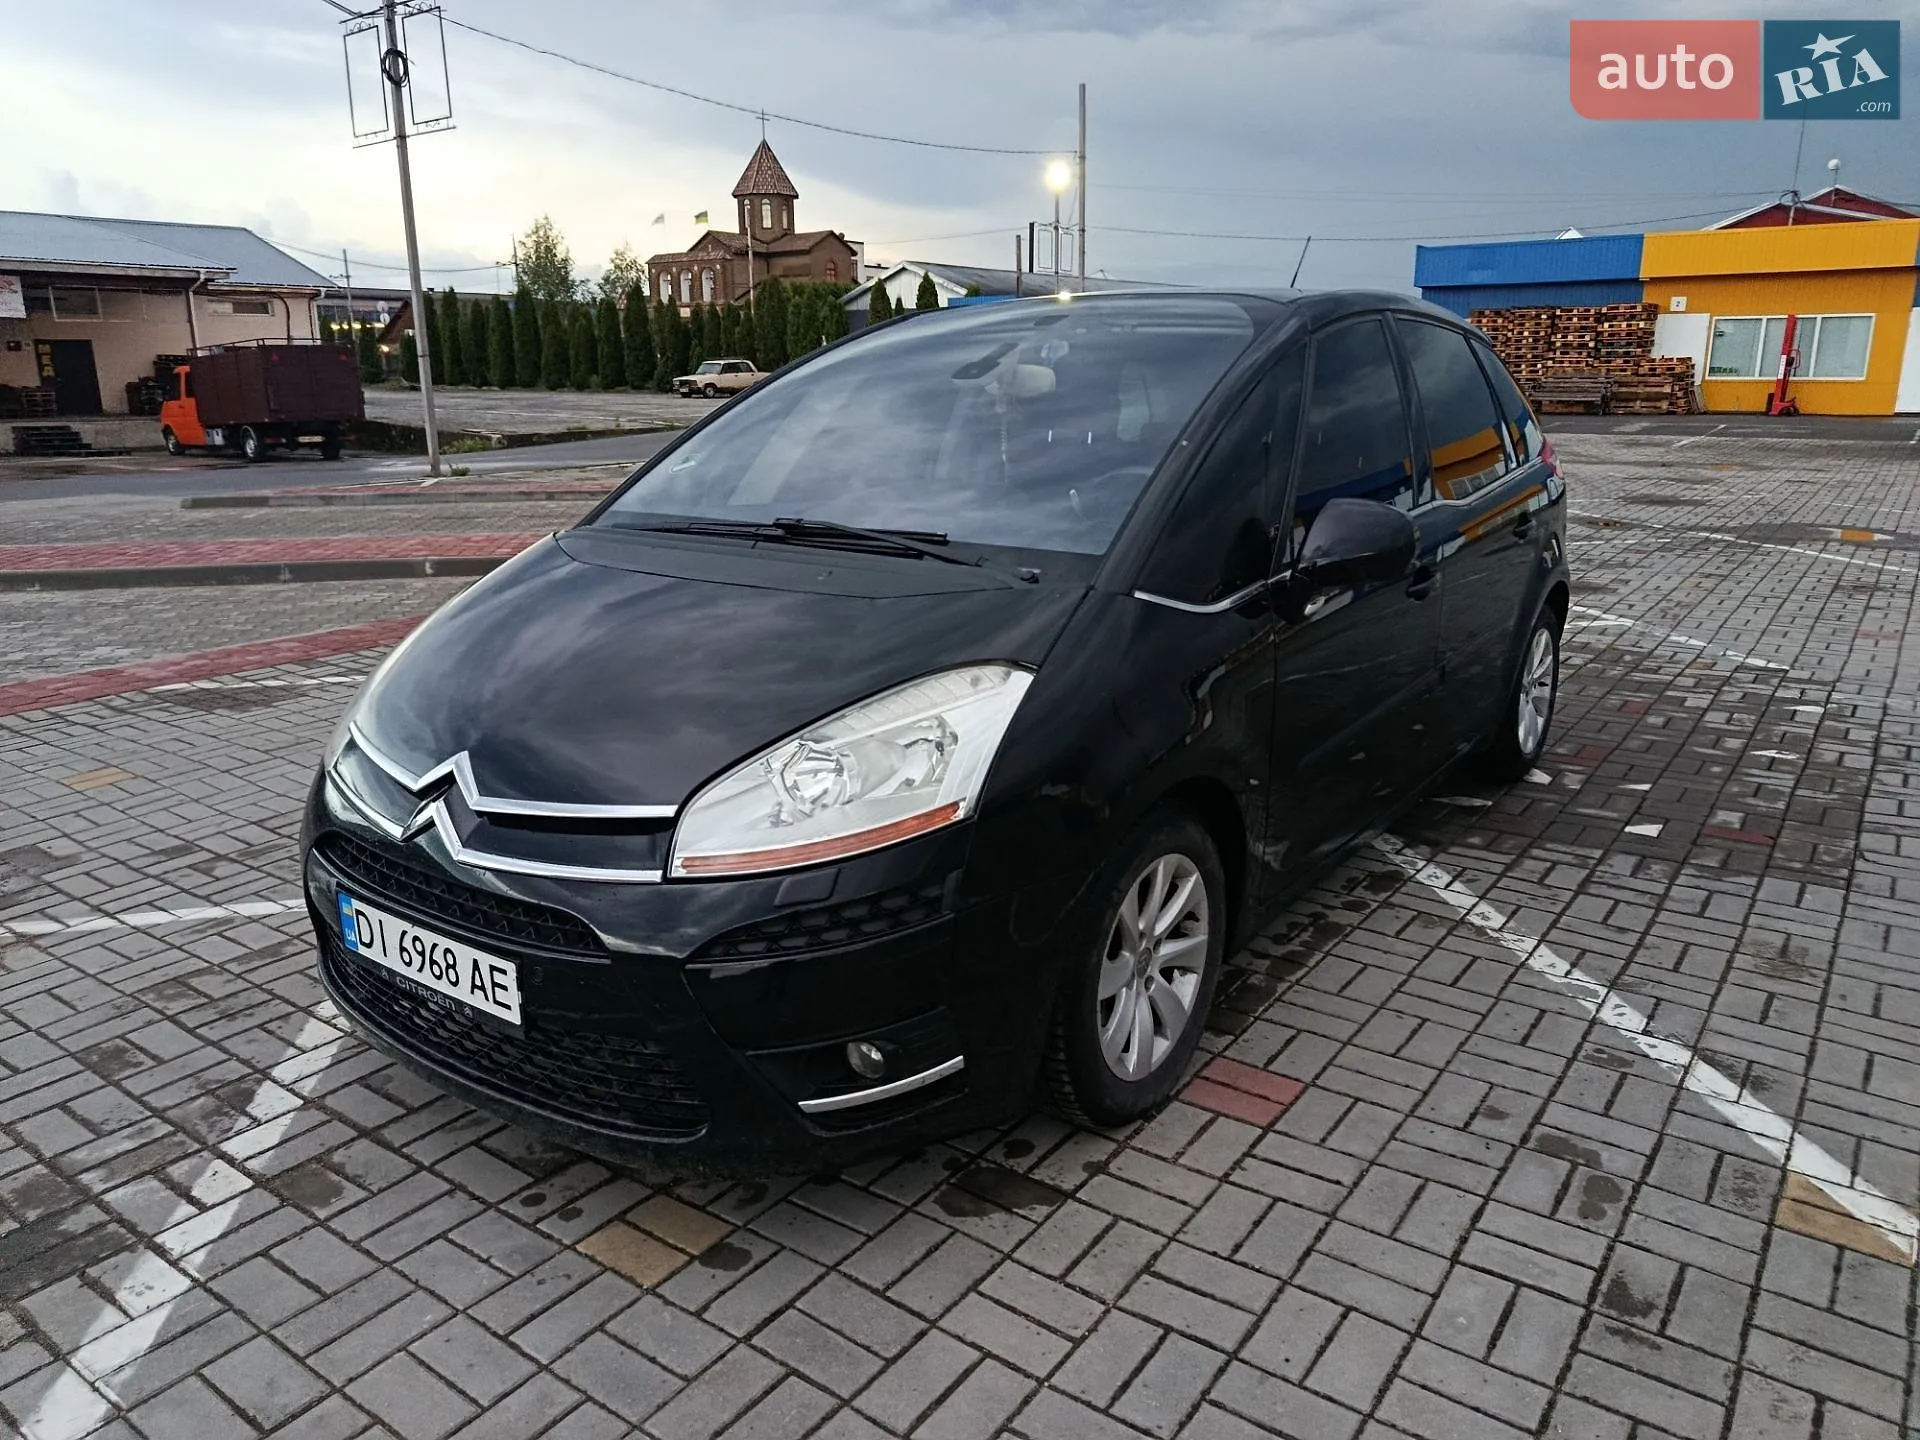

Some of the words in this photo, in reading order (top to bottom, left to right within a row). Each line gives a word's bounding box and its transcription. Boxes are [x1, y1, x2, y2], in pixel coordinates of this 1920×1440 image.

[354, 908, 387, 958] DI
[398, 929, 460, 988] 6968
[470, 957, 512, 1011] AE
